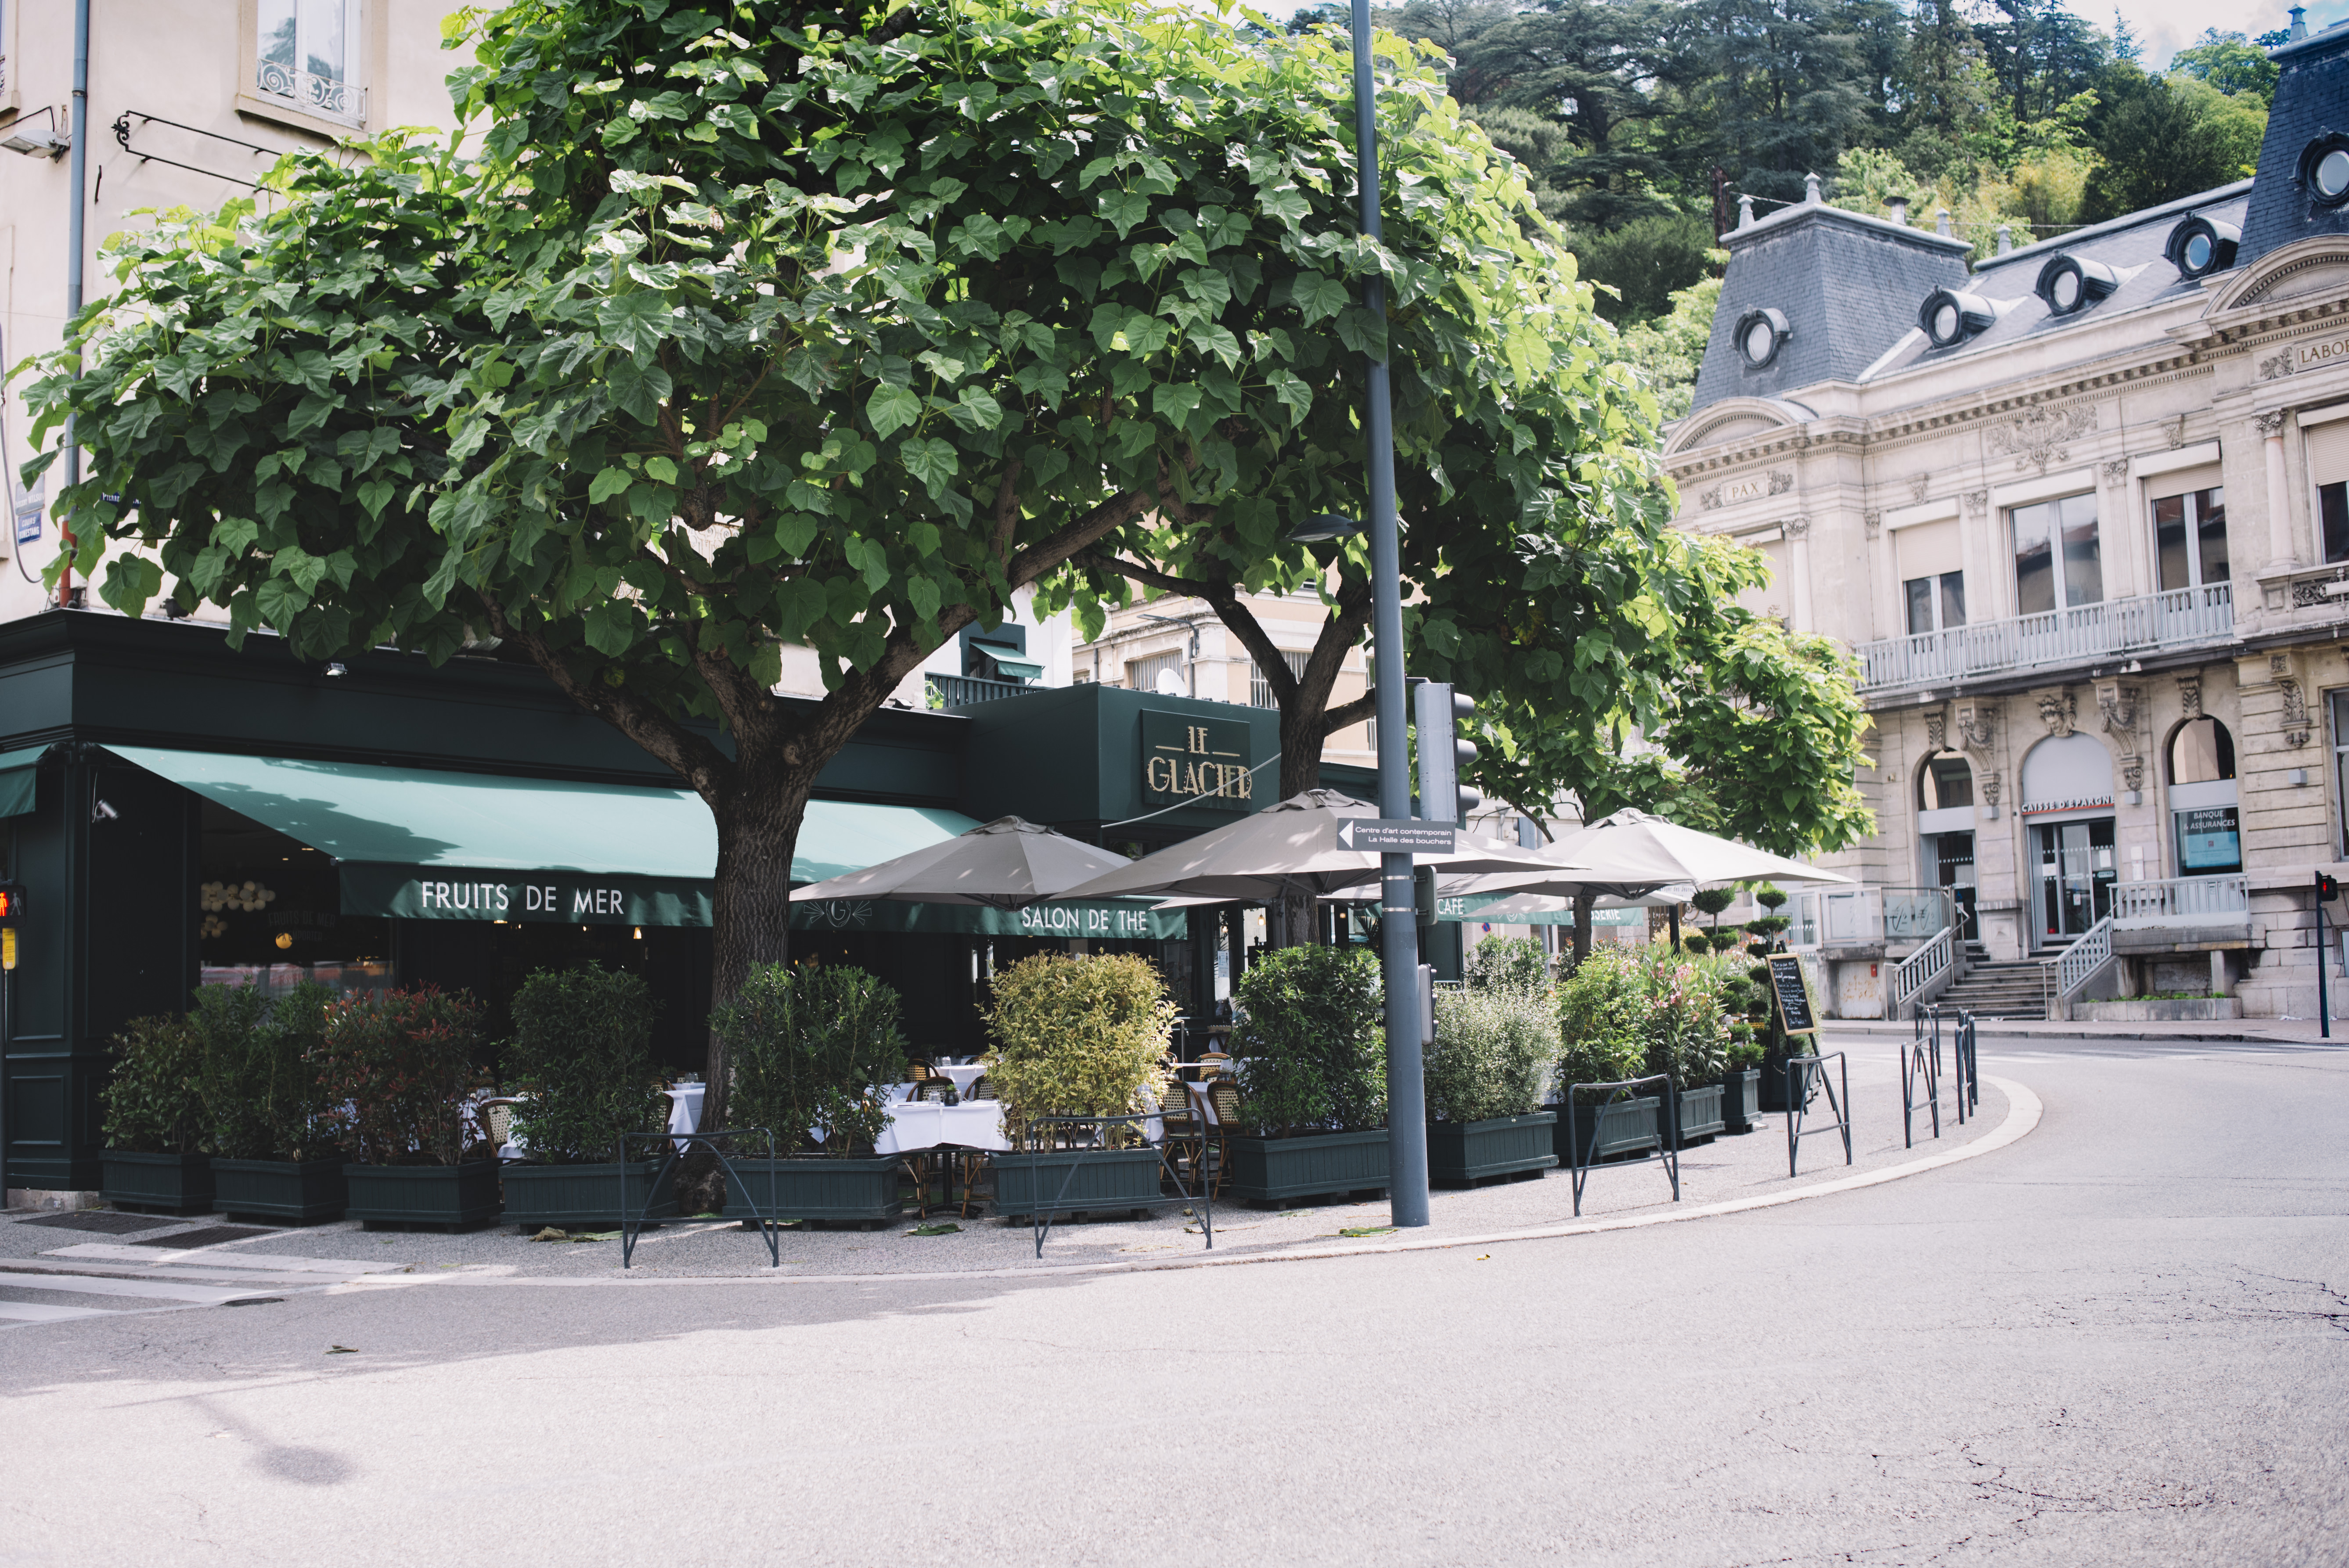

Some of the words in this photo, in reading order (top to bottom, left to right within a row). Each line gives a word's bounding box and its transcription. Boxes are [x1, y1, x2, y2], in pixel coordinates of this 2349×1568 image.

[1733, 482, 1758, 498] PAX
[28, 493, 44, 504] WILSON
[22, 516, 36, 527] COURS
[19, 526, 40, 539] ROMESTANG
[1188, 726, 1209, 754] LE
[1147, 756, 1252, 799] GLACIER
[2021, 801, 2055, 812] CAISSE
[2194, 810, 2224, 819] BANQUE
[2190, 819, 2235, 830] ASSURANCES
[422, 881, 509, 910] FRUITS
[527, 885, 556, 911] DE
[573, 887, 624, 914] MER
[1437, 898, 1463, 914] CAFE
[268, 911, 299, 927] FRUITS
[303, 911, 314, 925] DE
[317, 912, 335, 928] MER
[1022, 906, 1079, 929] SALON
[1089, 909, 1109, 929] DE
[1118, 910, 1146, 930] THE
